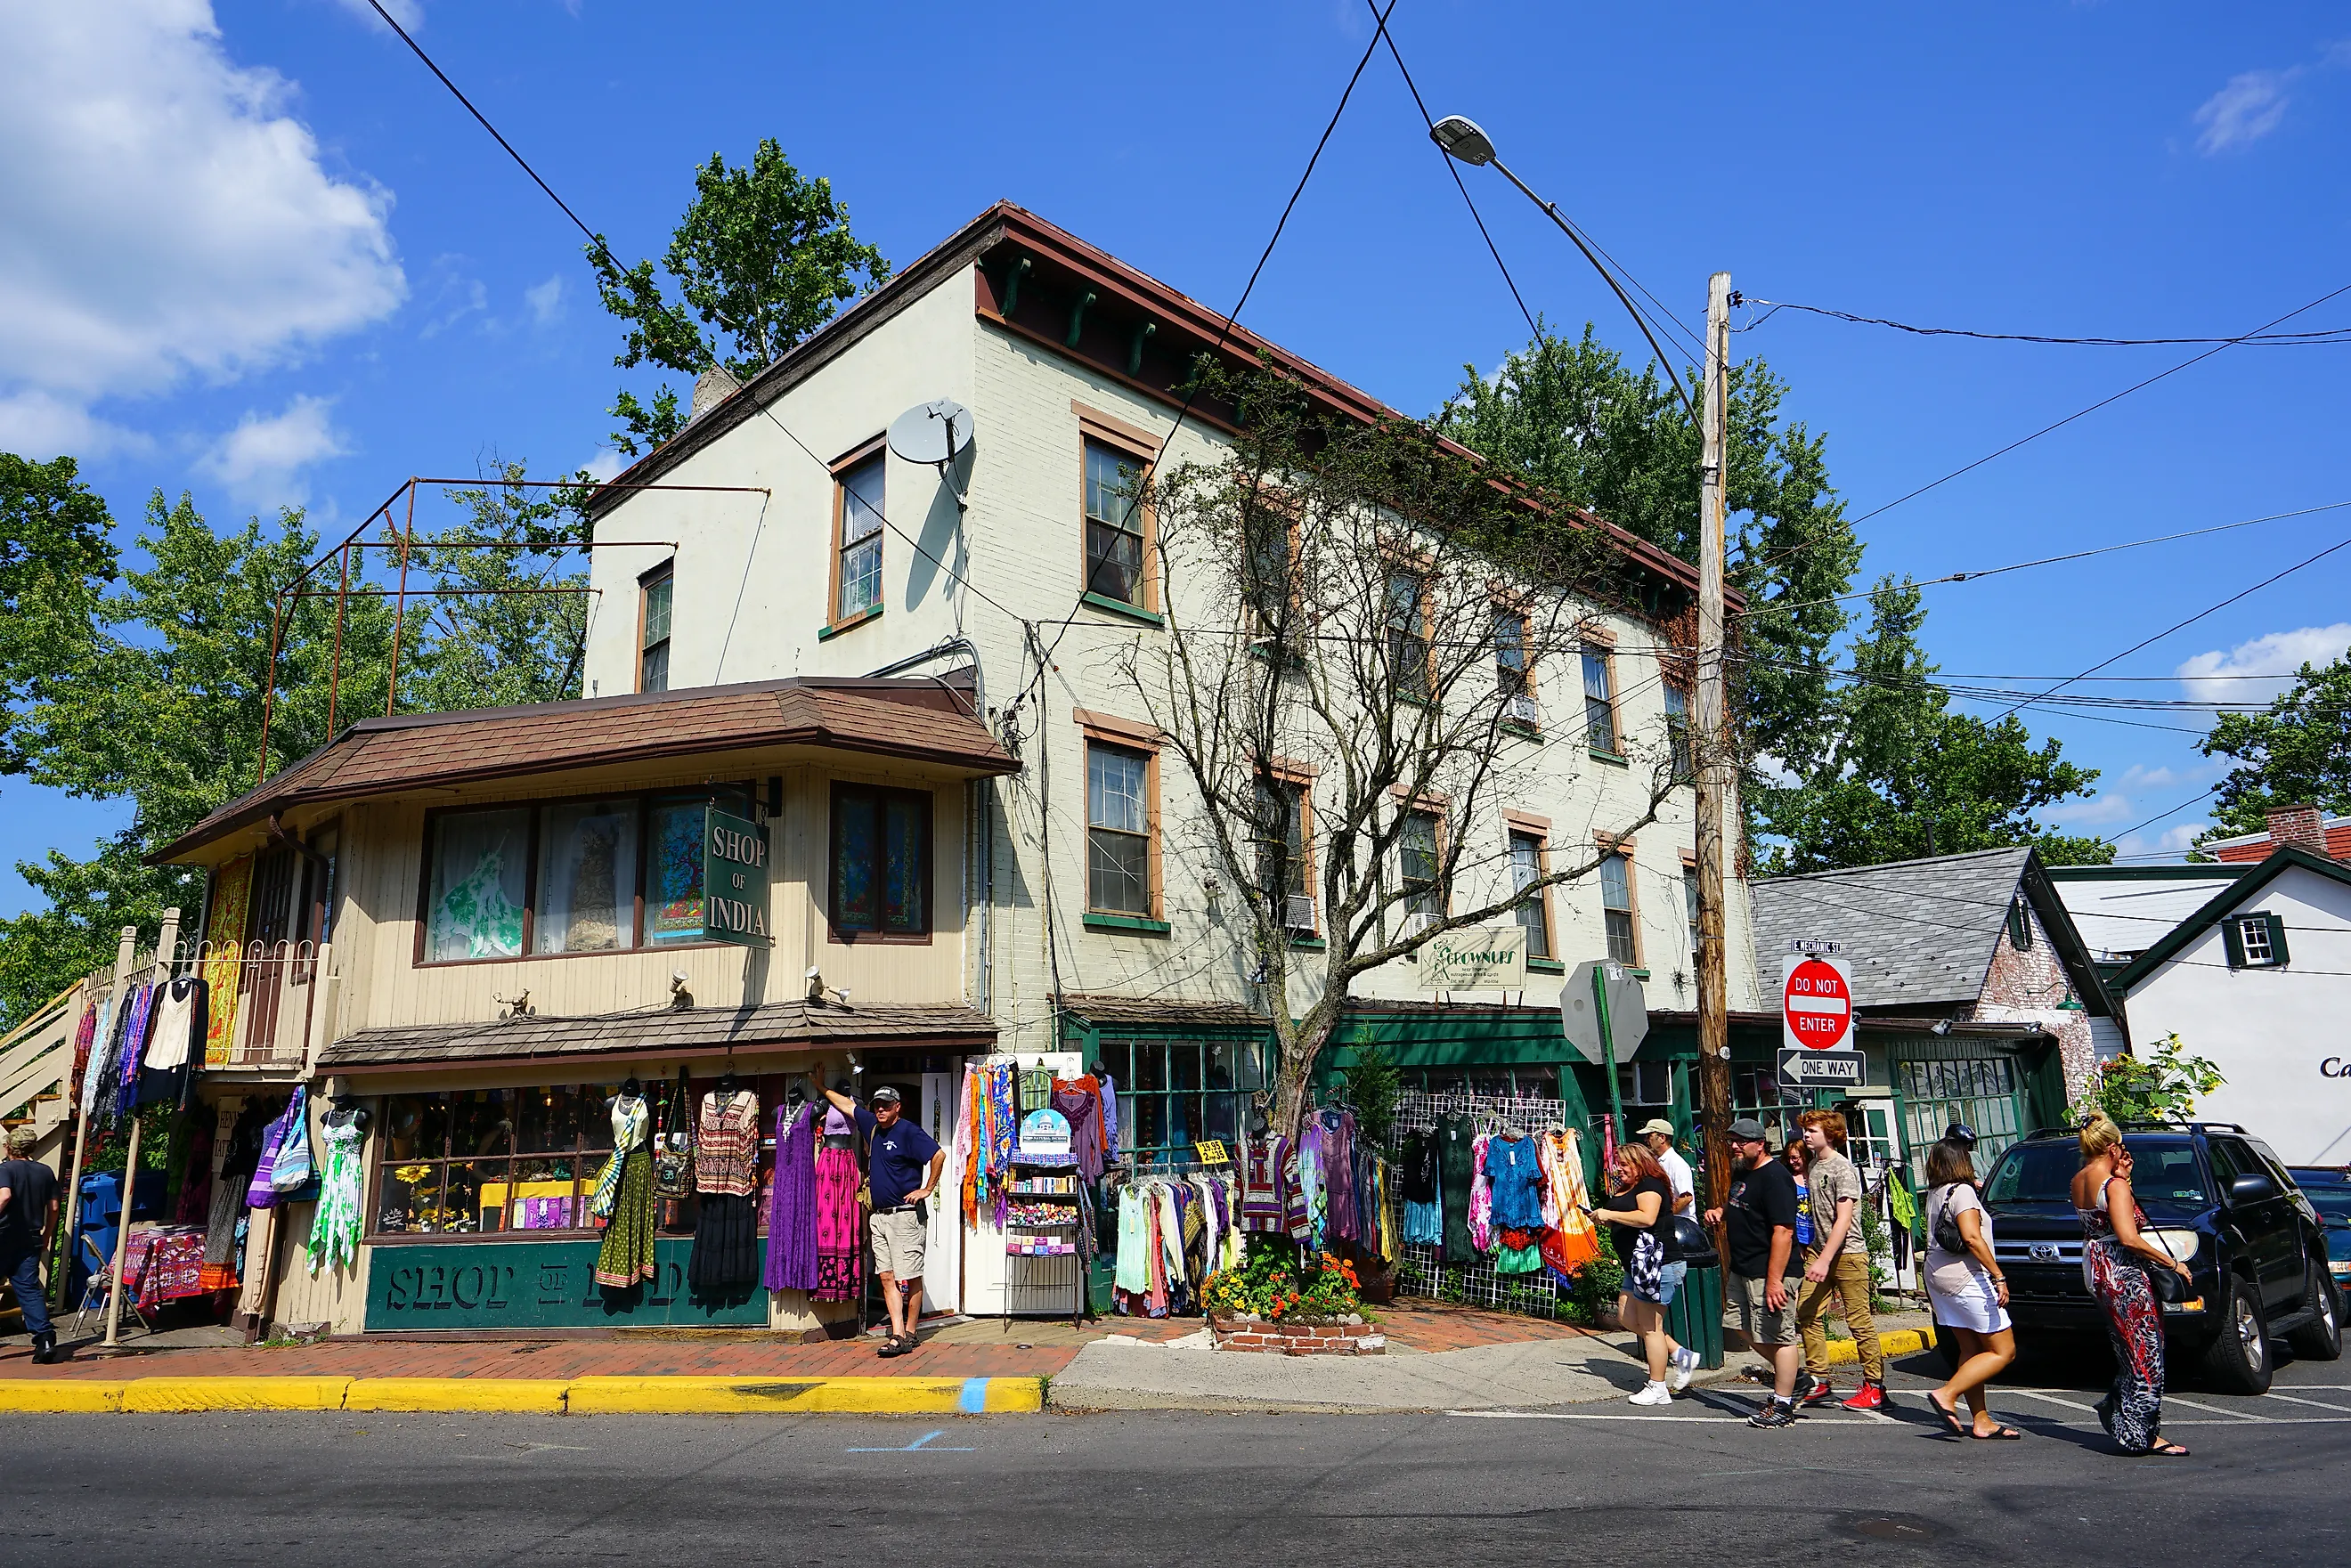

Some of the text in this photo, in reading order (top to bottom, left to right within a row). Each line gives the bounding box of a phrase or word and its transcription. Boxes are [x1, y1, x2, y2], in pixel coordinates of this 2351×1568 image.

[712, 825, 766, 868] SHOP
[731, 873, 746, 890] OF
[709, 895, 768, 937] INDIA
[1800, 940, 1831, 953] MECHANIC
[1446, 950, 1517, 965] GROWNUPS
[1795, 977, 1838, 994] DO NOT
[1799, 1017, 1836, 1033] ENTER
[1802, 1060, 1824, 1075] ONE
[1827, 1061, 1855, 1076] WAY
[1203, 1152, 1209, 1161] 2
[386, 1264, 514, 1311] SHOP
